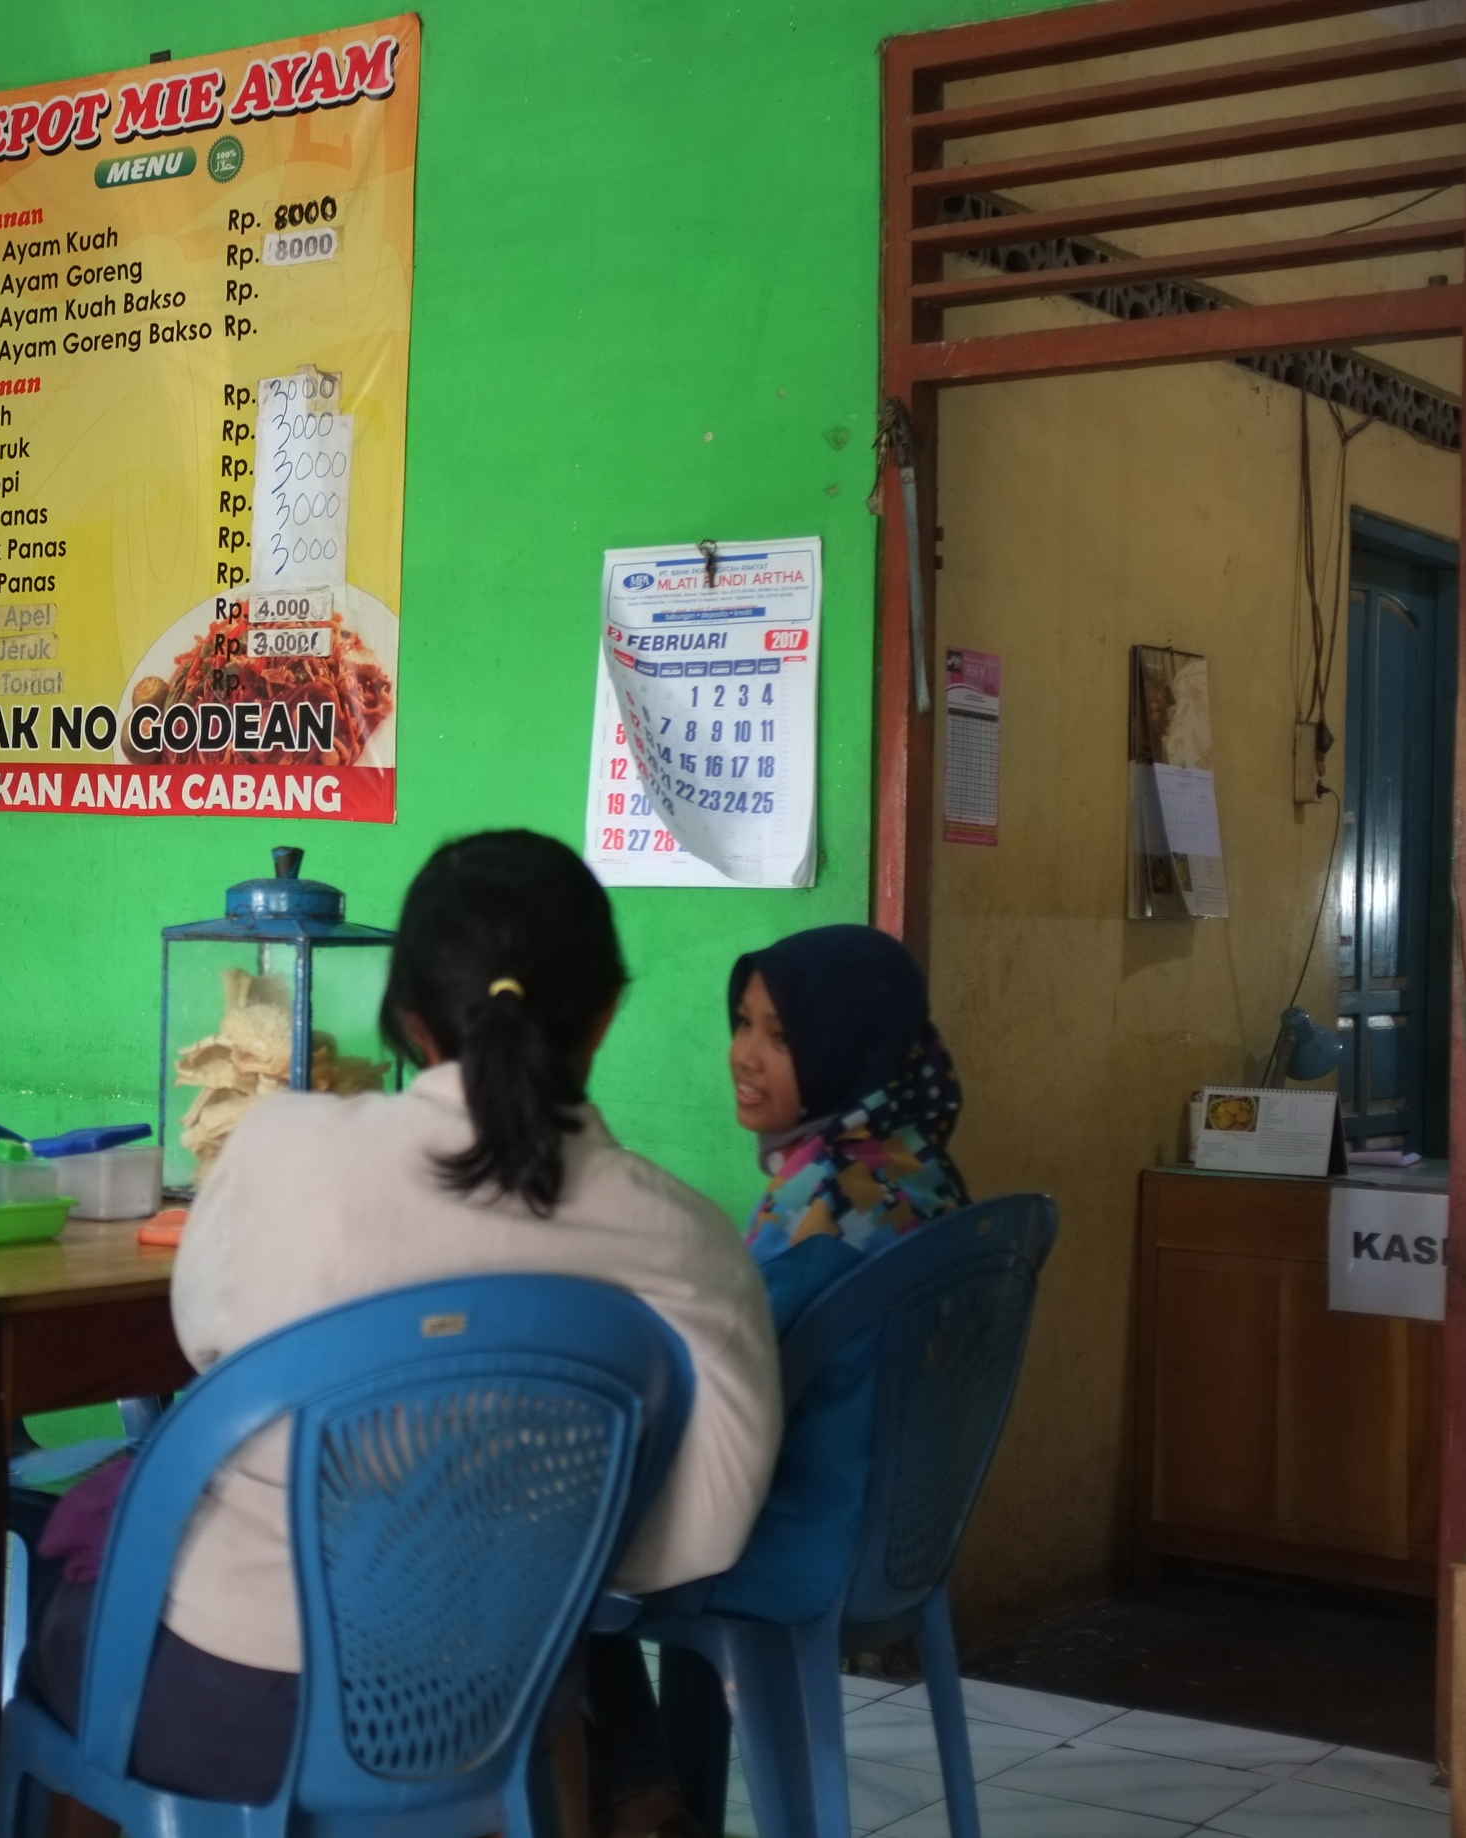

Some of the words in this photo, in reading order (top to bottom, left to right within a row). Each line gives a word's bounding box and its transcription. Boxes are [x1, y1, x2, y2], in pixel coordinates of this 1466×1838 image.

[113, 70, 227, 141] MIE
[228, 35, 399, 126] AYAM
[106, 151, 185, 184] MENU
[228, 209, 262, 235] Rp.
[274, 195, 337, 231] 8000
[2, 238, 61, 264] Ayam
[67, 227, 118, 253] Kuah
[226, 244, 260, 270] Rp.
[0, 272, 59, 298] Ayam
[66, 260, 143, 287] Goreng
[225, 279, 259, 305] Rp.
[0, 305, 58, 331] Ayam
[65, 295, 116, 320] Kuah
[123, 288, 186, 314] Bakso
[62, 327, 142, 353] Goreng
[149, 319, 213, 345] Bakso
[224, 314, 258, 340] Rp.
[224, 383, 256, 410] Rp.
[270, 375, 335, 417] 3000
[222, 420, 256, 446] Rp.
[272, 412, 334, 450] 3000
[221, 455, 254, 482] Rp.
[271, 449, 347, 495] 3000
[220, 491, 252, 517] Rp.
[276, 492, 340, 531] 3000
[7, 538, 67, 561] Panas
[218, 526, 251, 553] Rp.
[270, 532, 337, 576] 3000
[217, 562, 250, 589] Rp.
[657, 577, 698, 591] MLATI
[752, 569, 805, 585] ARTHA
[4, 603, 51, 632] Apel
[215, 597, 249, 624] Rp.
[627, 632, 728, 651] FEBRUARI
[771, 631, 802, 649] 2017
[691, 686, 699, 707] 1
[714, 685, 725, 707] 2
[738, 684, 749, 706] 3
[762, 683, 774, 705] 4
[50, 704, 118, 751] NO
[130, 702, 336, 752] GODEAN
[616, 723, 626, 745] 5
[661, 717, 671, 735] 7
[685, 720, 697, 742] 8
[711, 720, 723, 742] 9
[735, 720, 751, 742] 10
[761, 719, 774, 742] 11
[610, 758, 628, 780] 12
[679, 753, 697, 773] 15
[705, 755, 723, 777] 16
[731, 756, 750, 778] 17
[758, 756, 774, 778] 18
[71, 773, 173, 809] ANAK
[181, 774, 342, 813] CABANG
[607, 793, 625, 815] 19
[630, 793, 652, 816] 20
[676, 779, 696, 803] 22
[698, 788, 721, 811] 23
[723, 791, 747, 813] 24
[752, 791, 774, 813] 25
[602, 828, 624, 850] 26
[628, 829, 650, 851] 27
[654, 830, 675, 851] 28
